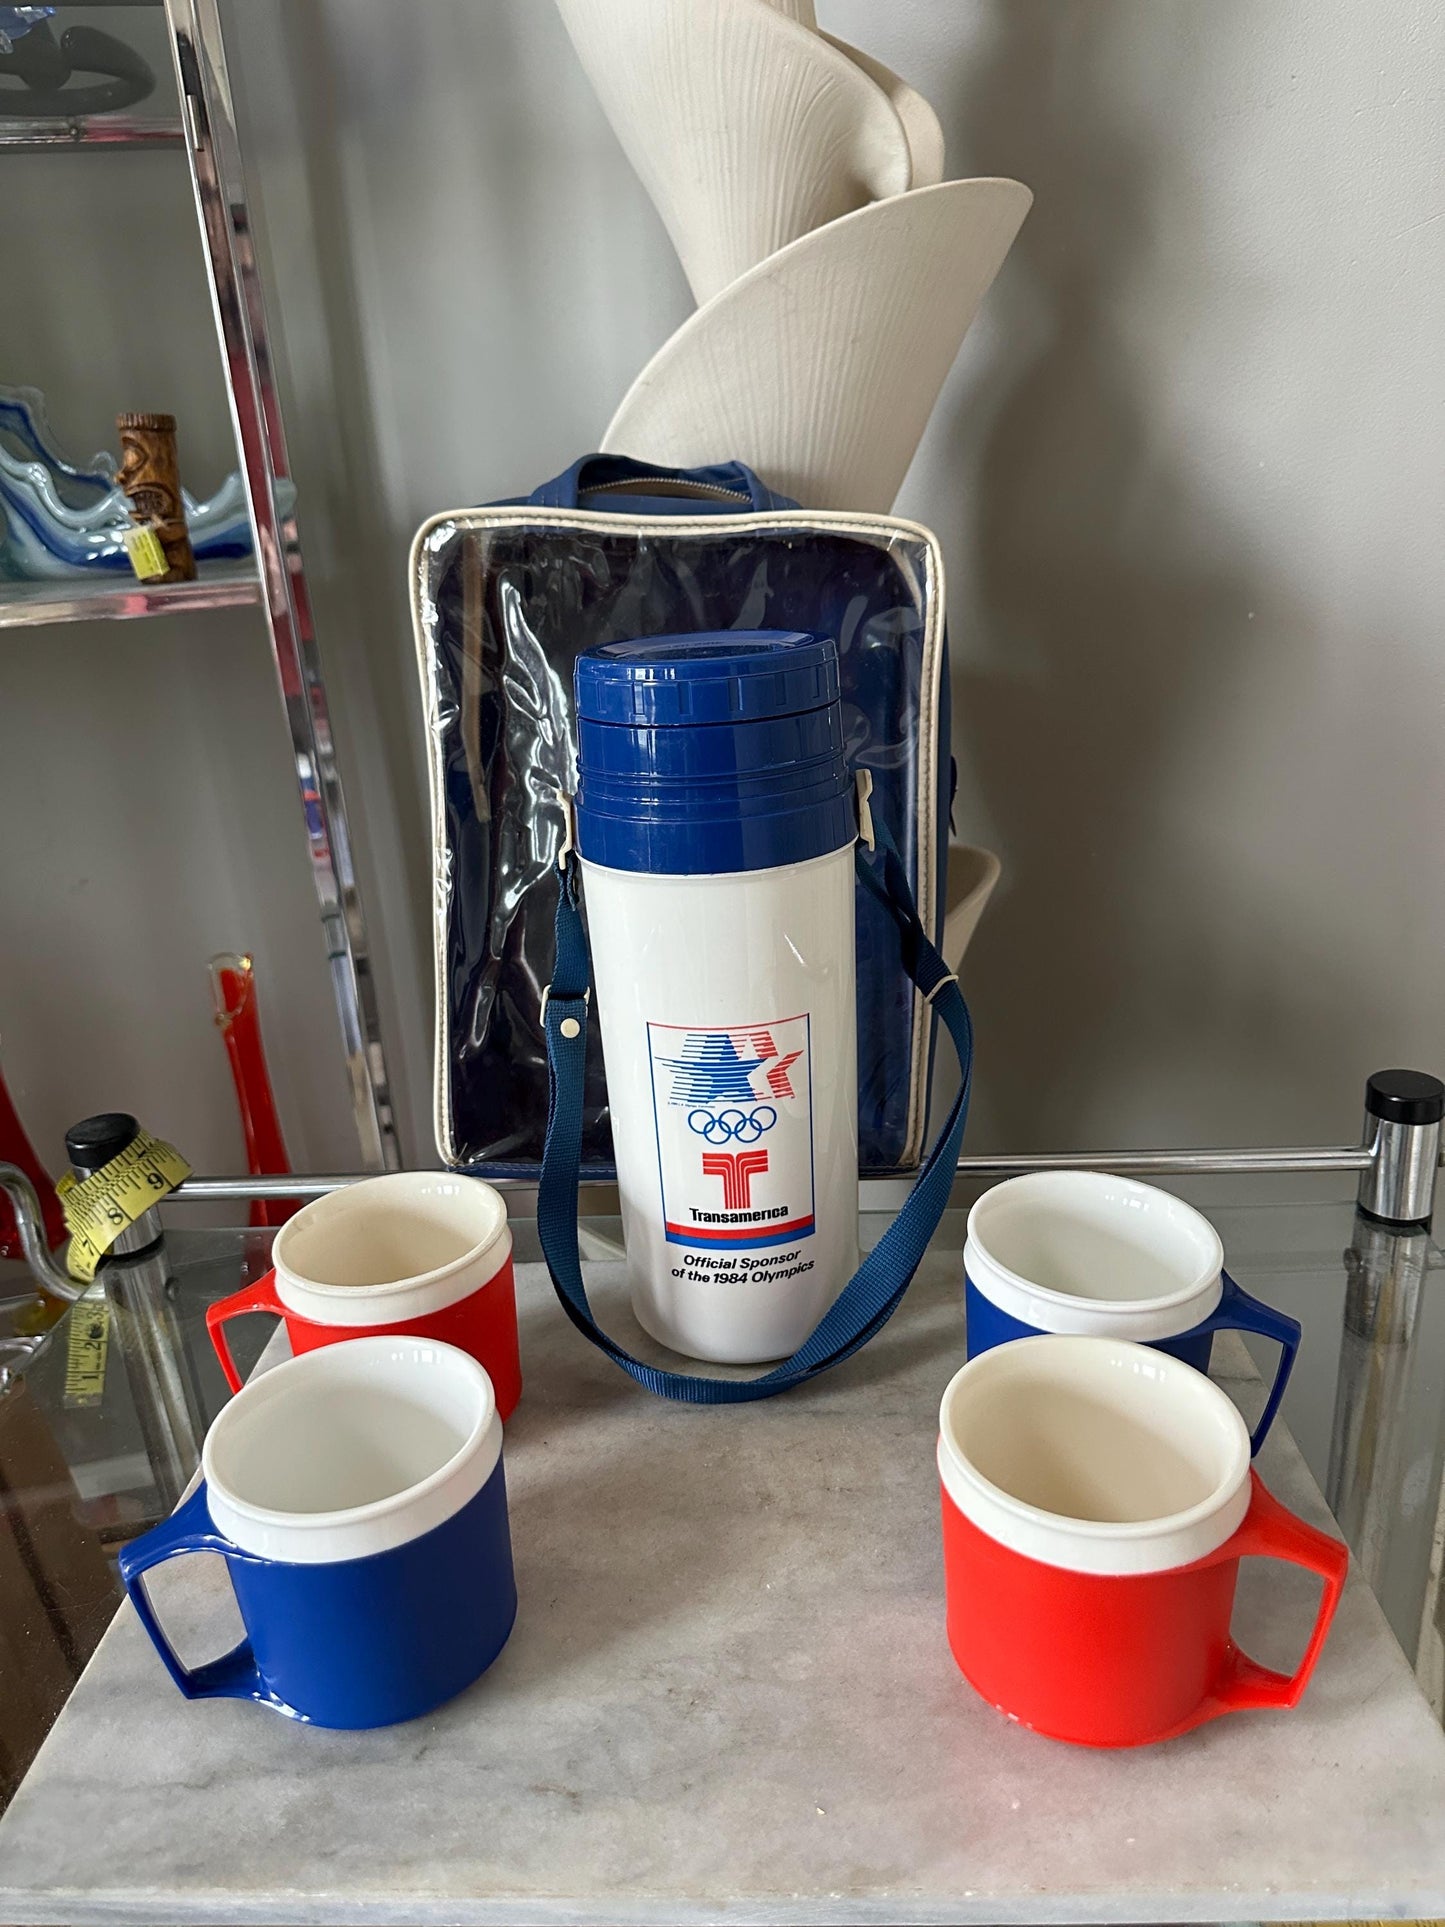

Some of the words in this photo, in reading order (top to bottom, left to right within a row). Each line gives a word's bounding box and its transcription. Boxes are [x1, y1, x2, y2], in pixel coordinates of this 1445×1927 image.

[83, 1239, 95, 1257] 7
[107, 1207, 124, 1226] 8
[147, 1172, 165, 1190] 9
[688, 1206, 789, 1223] Transamerica
[683, 1254, 737, 1270] Official
[739, 1250, 802, 1271] Sponsor
[671, 1268, 686, 1279] of
[688, 1271, 711, 1284] the
[713, 1272, 748, 1284] 1984
[751, 1259, 815, 1284] Olympics
[84, 1341, 102, 1351] 2
